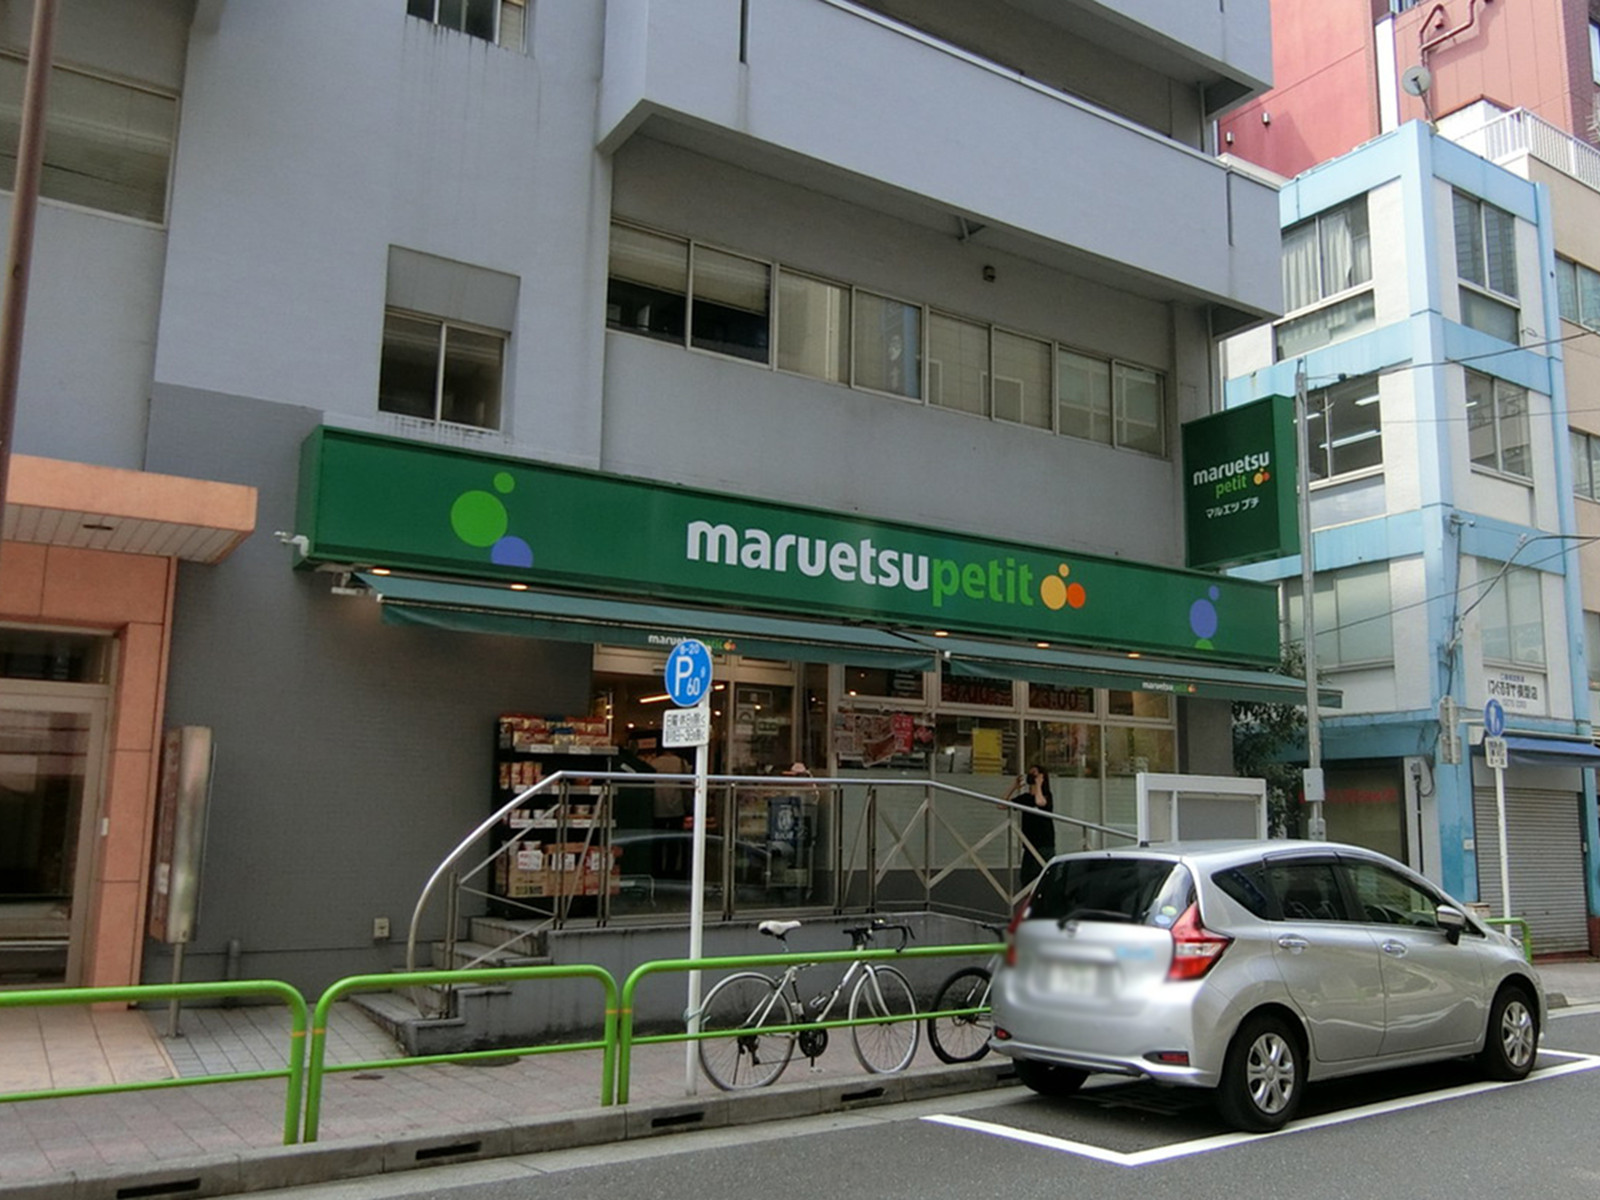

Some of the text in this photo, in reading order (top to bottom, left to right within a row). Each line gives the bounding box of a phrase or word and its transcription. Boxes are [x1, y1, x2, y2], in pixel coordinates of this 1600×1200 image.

[1193, 451, 1270, 486] maruetsu
[1215, 474, 1247, 499] petit
[1206, 496, 1260, 519] マルエツ プチ
[686, 520, 1035, 608] maruetsu petit
[675, 655, 694, 697] P
